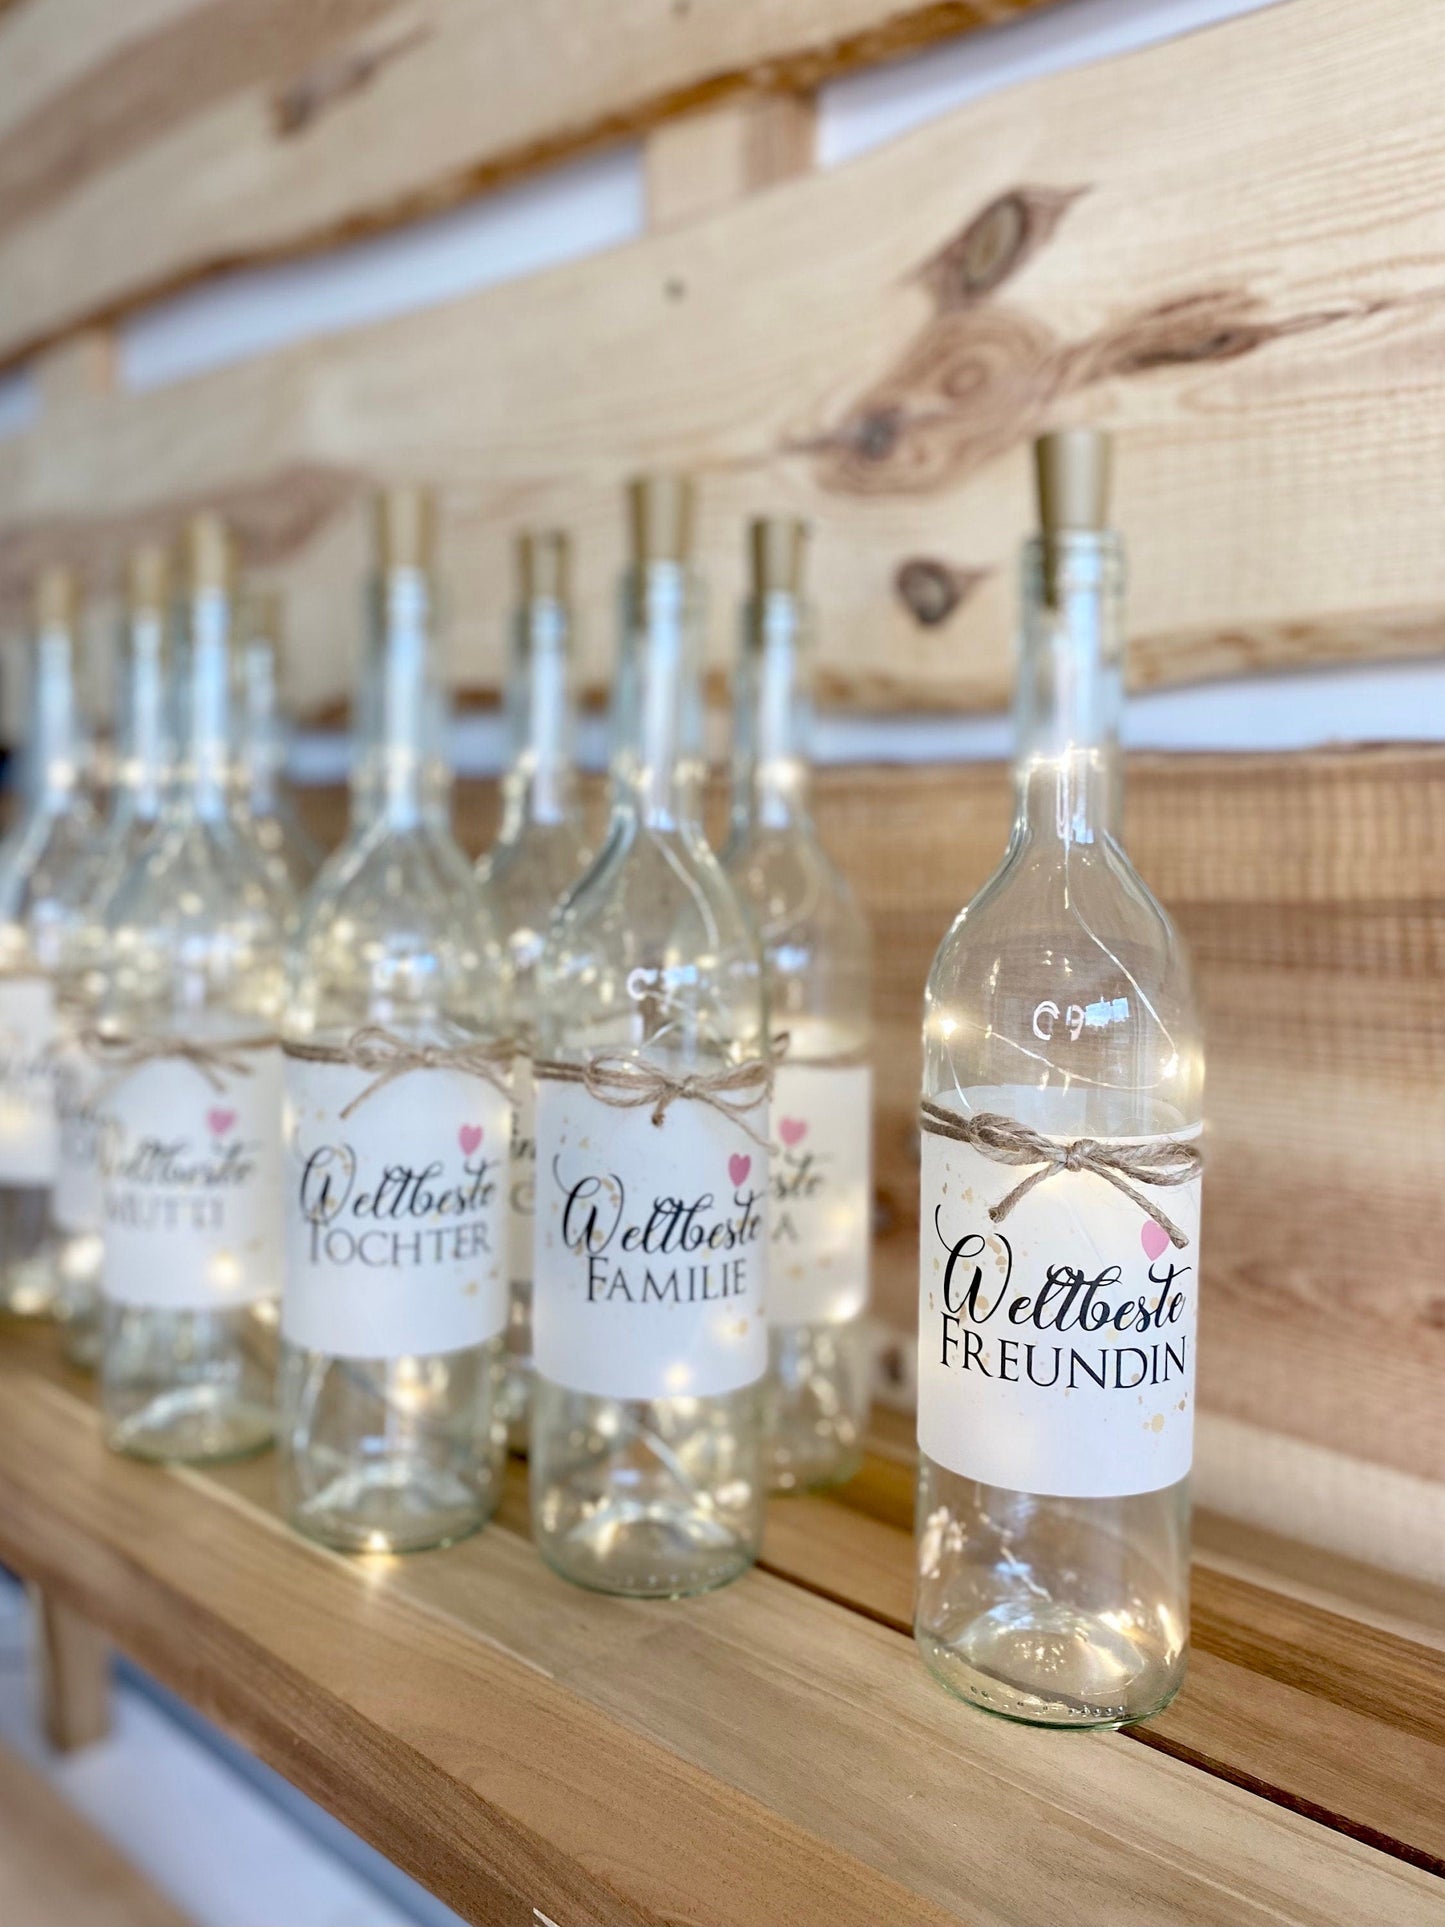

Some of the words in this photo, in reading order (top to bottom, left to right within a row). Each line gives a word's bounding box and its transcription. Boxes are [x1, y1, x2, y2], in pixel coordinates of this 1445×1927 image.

[297, 1142, 500, 1226] Weltbeste
[553, 1154, 765, 1254] Weltbeste
[308, 1219, 492, 1267] TOCHTER
[586, 1256, 747, 1303] FAMILIE
[935, 1204, 1191, 1332] Weltbeste
[940, 1311, 1186, 1389] FREUNDIN
